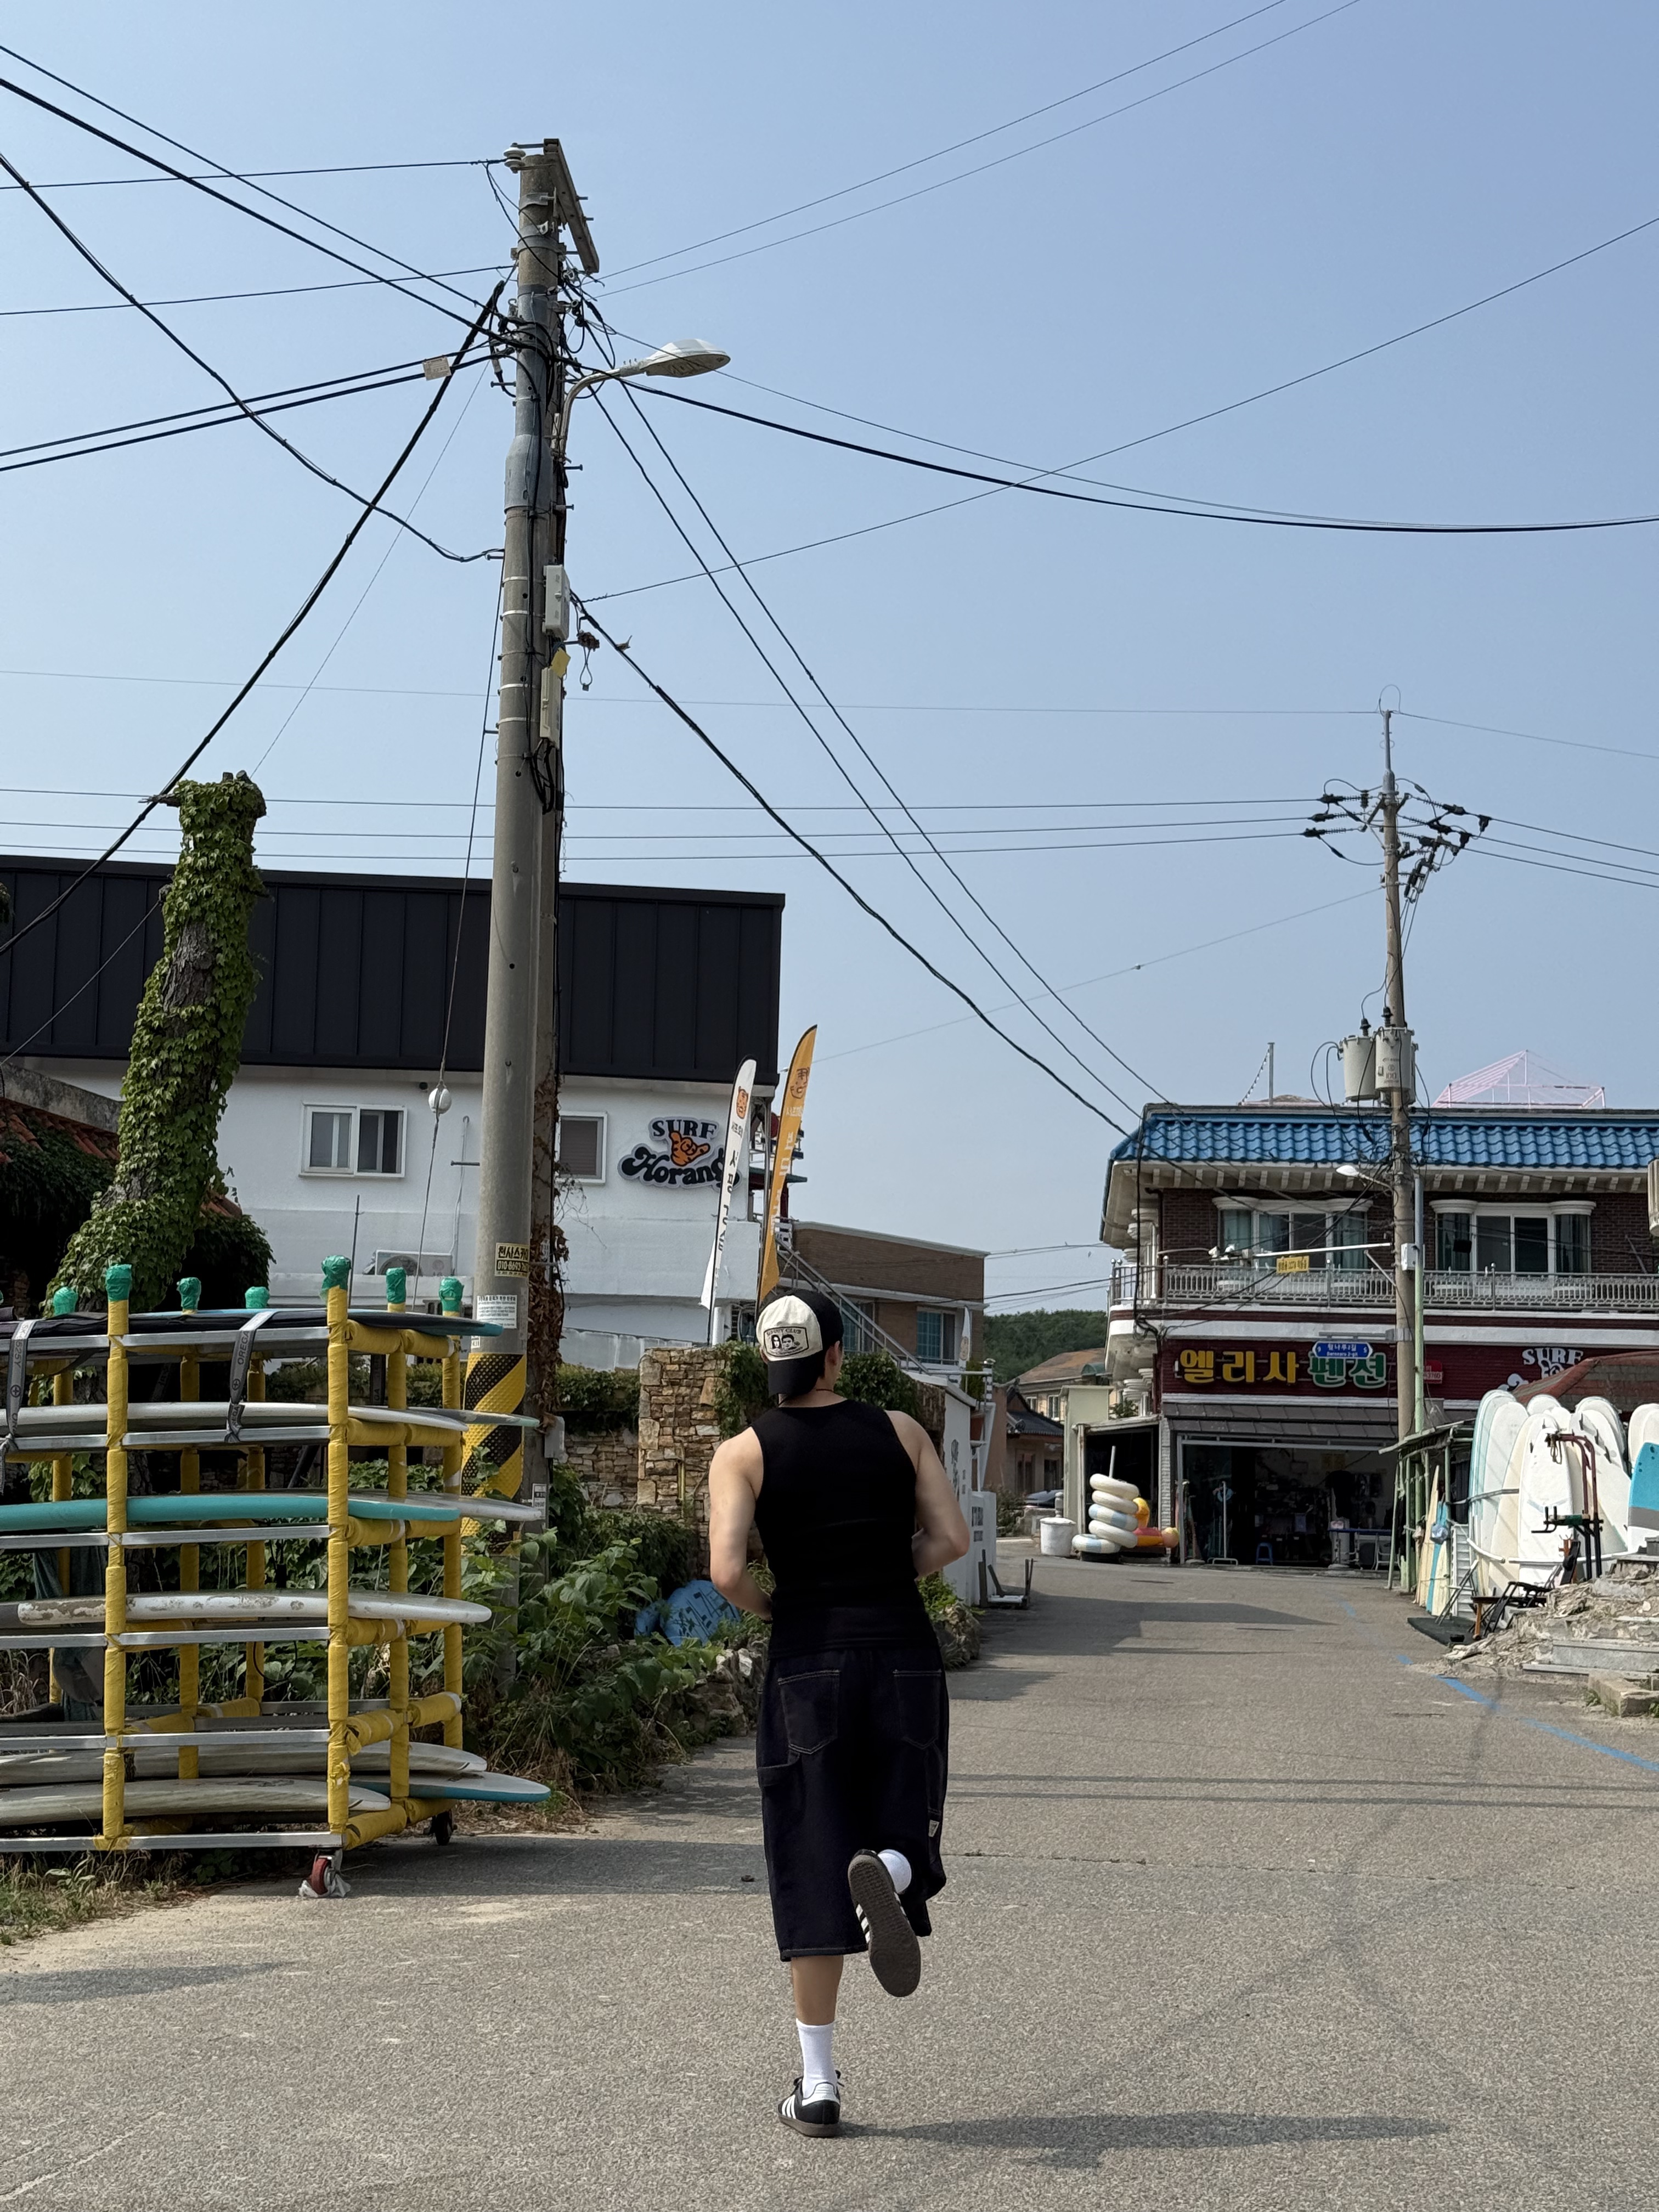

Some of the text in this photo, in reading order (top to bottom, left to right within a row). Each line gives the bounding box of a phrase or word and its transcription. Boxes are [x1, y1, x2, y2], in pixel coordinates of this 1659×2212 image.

[652, 1119, 717, 1139] SURF
[1522, 1348, 1583, 1365] SURF
[1180, 1350, 1387, 1389] 엘리사 펜션
